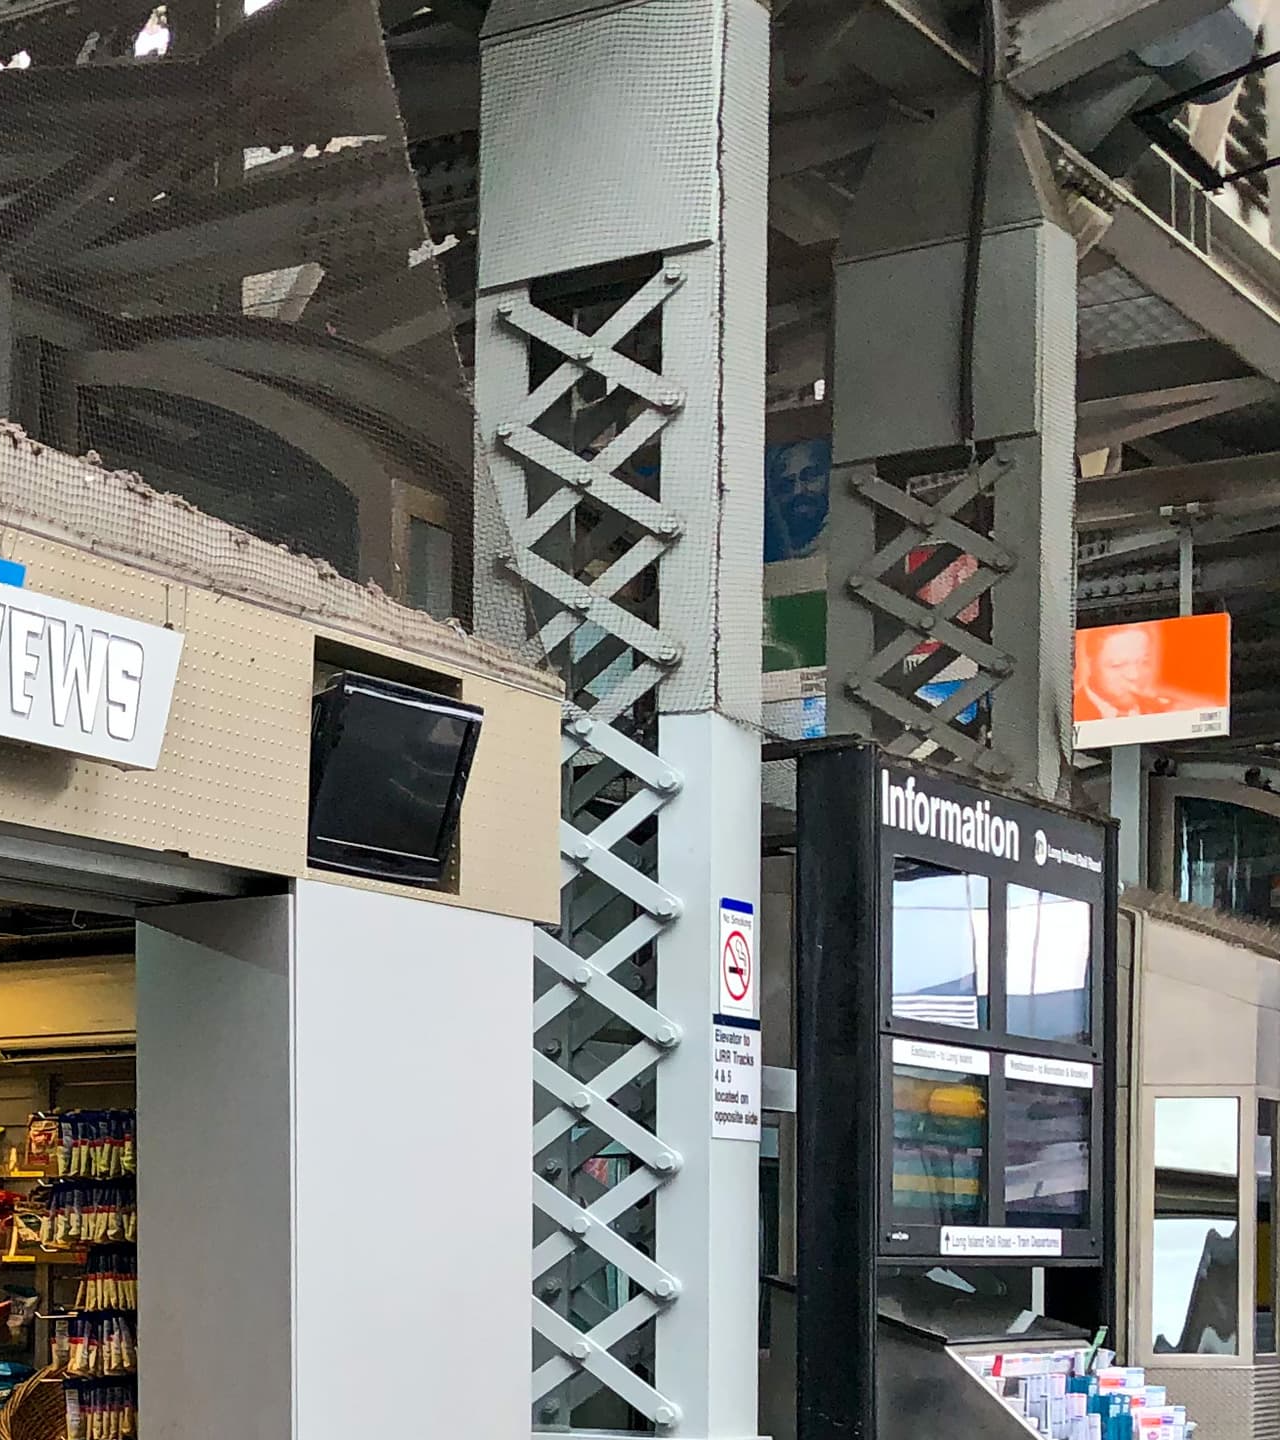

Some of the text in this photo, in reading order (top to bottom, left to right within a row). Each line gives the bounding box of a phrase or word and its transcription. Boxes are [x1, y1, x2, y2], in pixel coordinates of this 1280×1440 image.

[881, 768, 1020, 863] Information
[714, 1028, 750, 1047] Elevator to
[733, 1050, 755, 1067] Tracks
[714, 1069, 719, 1082] 4
[714, 1087, 749, 1105] located on
[714, 1110, 759, 1126] opposite side
